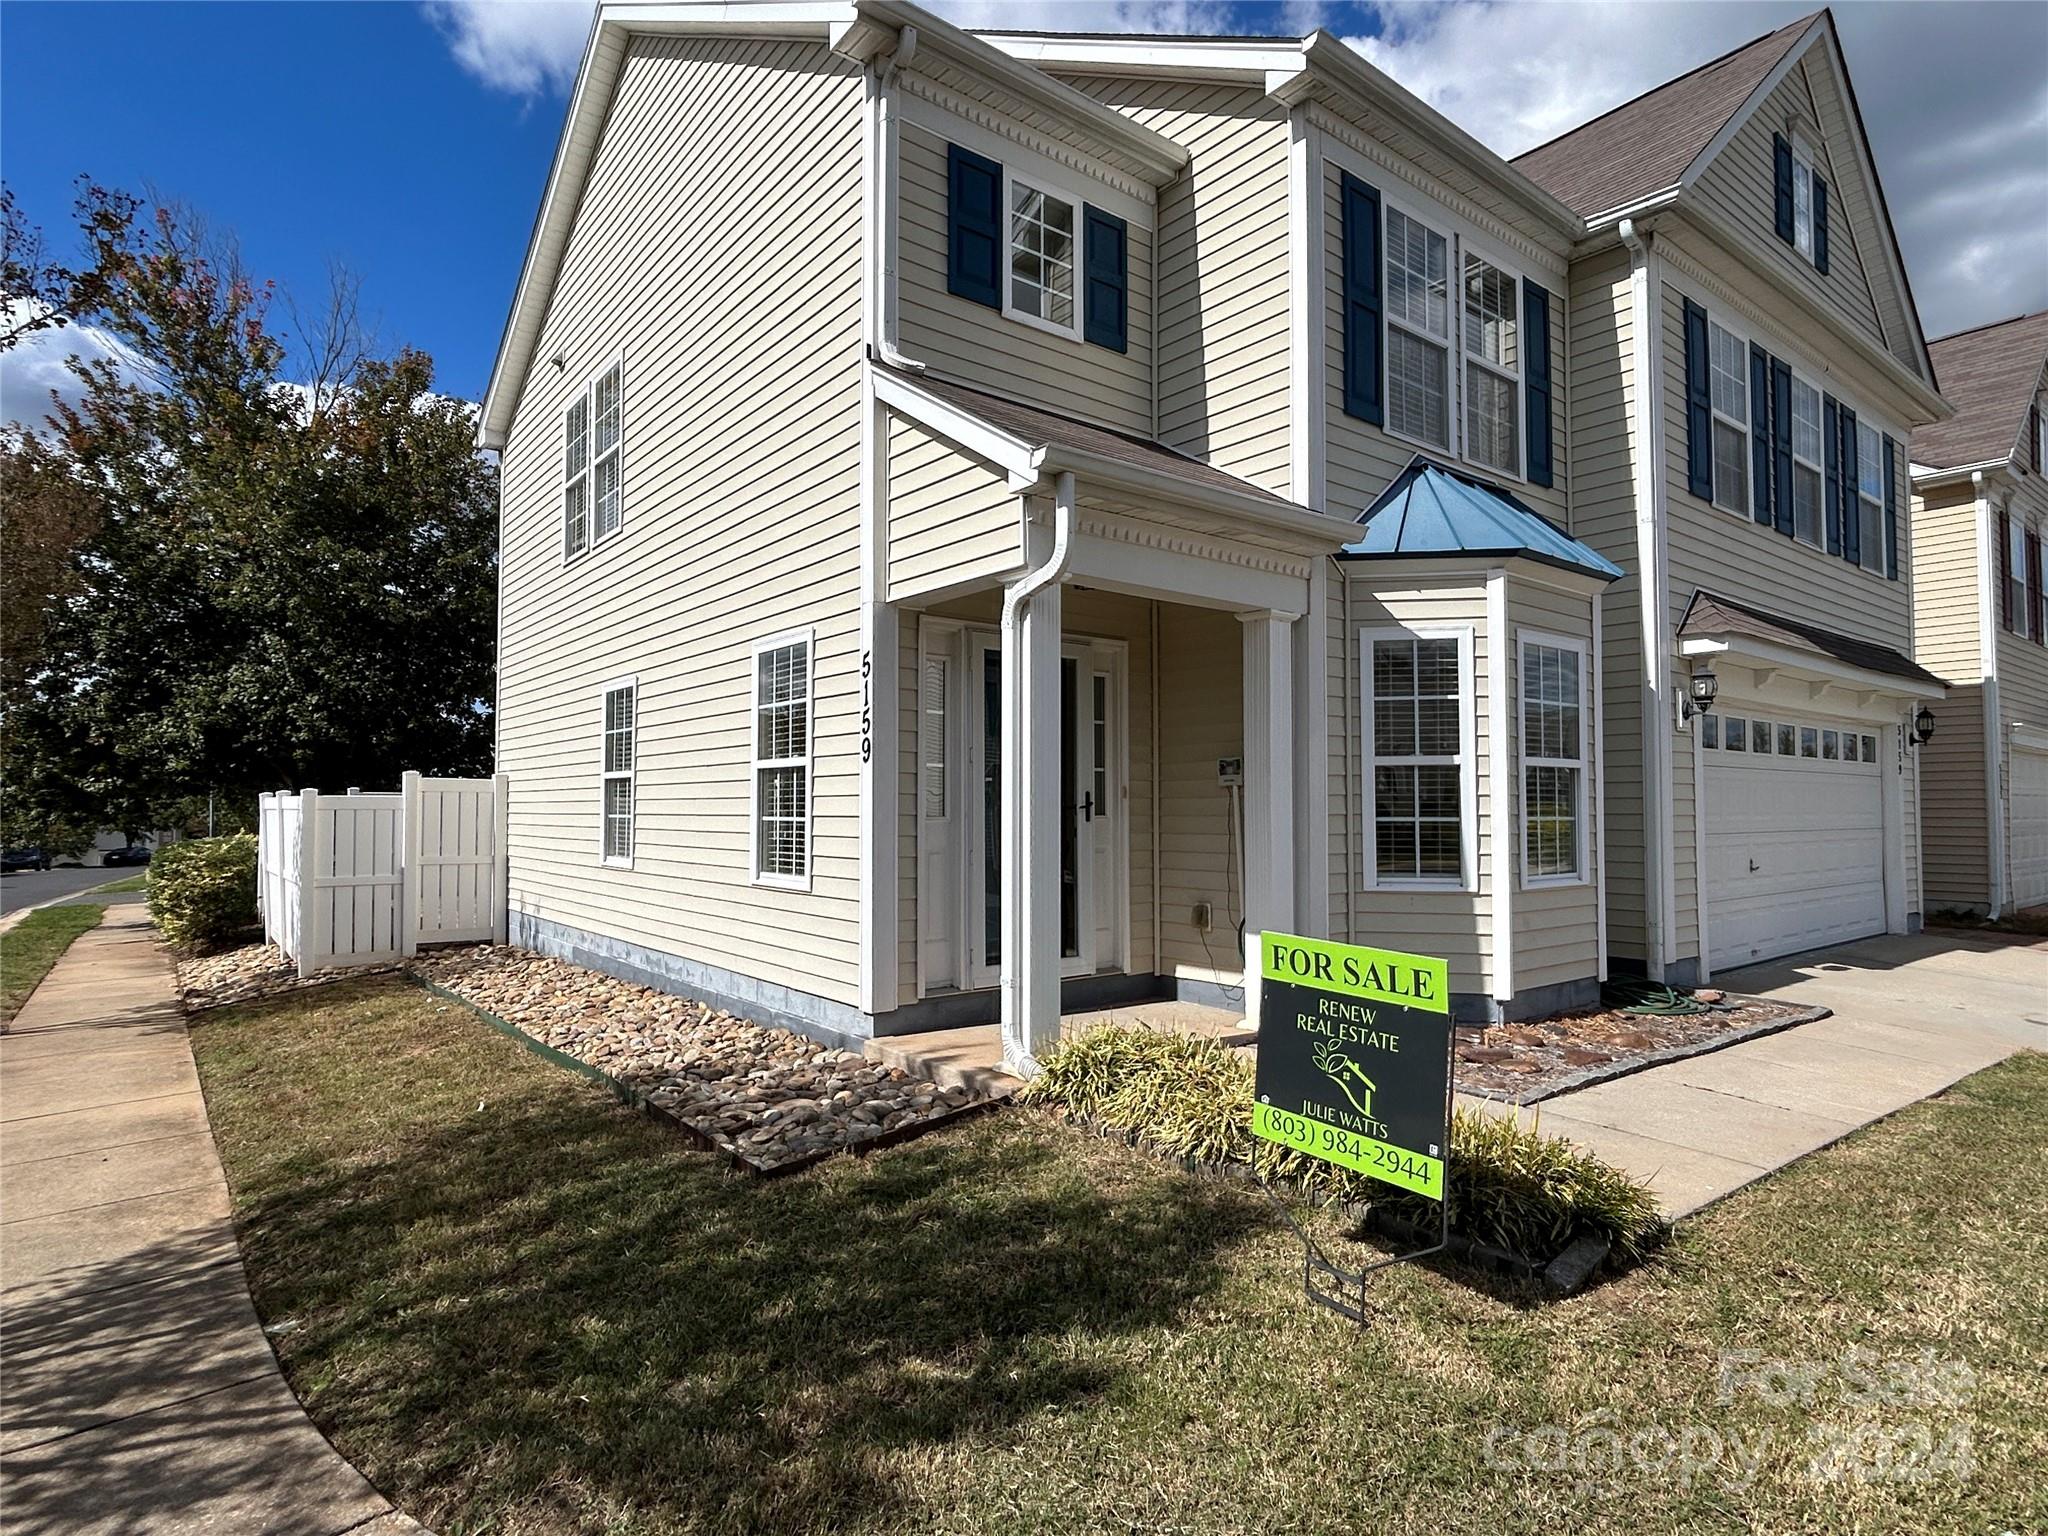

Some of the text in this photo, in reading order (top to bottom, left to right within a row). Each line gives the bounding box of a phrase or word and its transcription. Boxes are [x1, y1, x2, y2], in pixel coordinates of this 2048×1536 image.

[861, 650, 871, 763] 5159
[1271, 944, 1434, 1000] FOR SALE
[1296, 1014, 1399, 1053] REAL ESTATE
[1319, 998, 1377, 1025] RENEW
[1301, 1099, 1389, 1140] JULIE WATTS
[1263, 1108, 1432, 1185] (803) 984-2944
